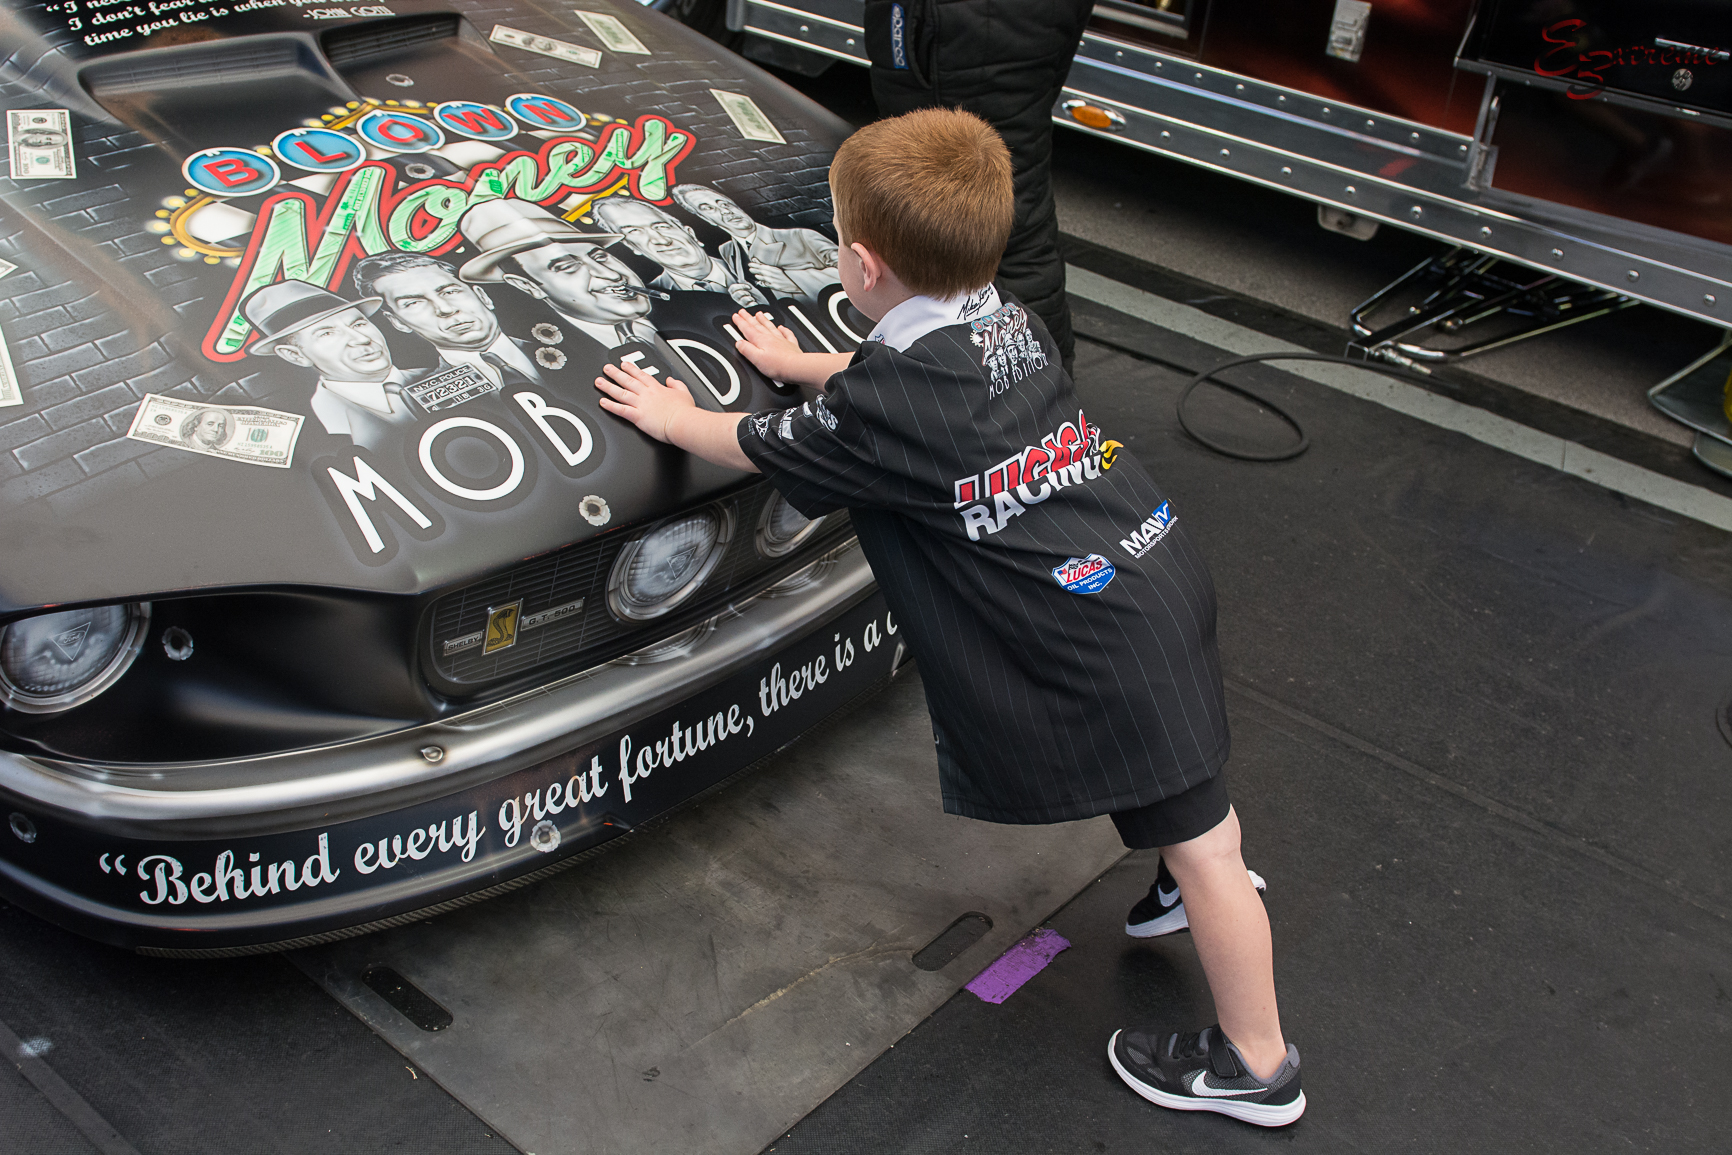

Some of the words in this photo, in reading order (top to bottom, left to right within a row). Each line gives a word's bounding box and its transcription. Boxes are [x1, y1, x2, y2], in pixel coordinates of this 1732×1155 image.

[68, 17, 83, 31] I
[148, 0, 195, 16] fear
[83, 28, 134, 46] time
[136, 18, 179, 36] you
[179, 11, 209, 23] lie
[209, 7, 229, 17] is
[200, 98, 574, 190] BLOWN
[207, 116, 692, 360] Money
[439, 366, 471, 382] POLICE
[989, 375, 1010, 400] MOB
[426, 376, 477, 401] 72321
[259, 449, 284, 457] 100
[327, 391, 593, 553] MOB
[1066, 559, 1103, 583] LUCAS
[1066, 583, 1079, 591] OIL
[1079, 568, 1113, 586] PRODUCTS
[1088, 582, 1103, 590] INC.
[448, 636, 480, 650] SHELBY
[554, 604, 576, 617] 500
[354, 809, 487, 874] every
[498, 754, 609, 848] great
[618, 704, 755, 803] fortune,
[758, 662, 830, 717] there
[833, 632, 856, 674] is
[863, 619, 882, 652] a
